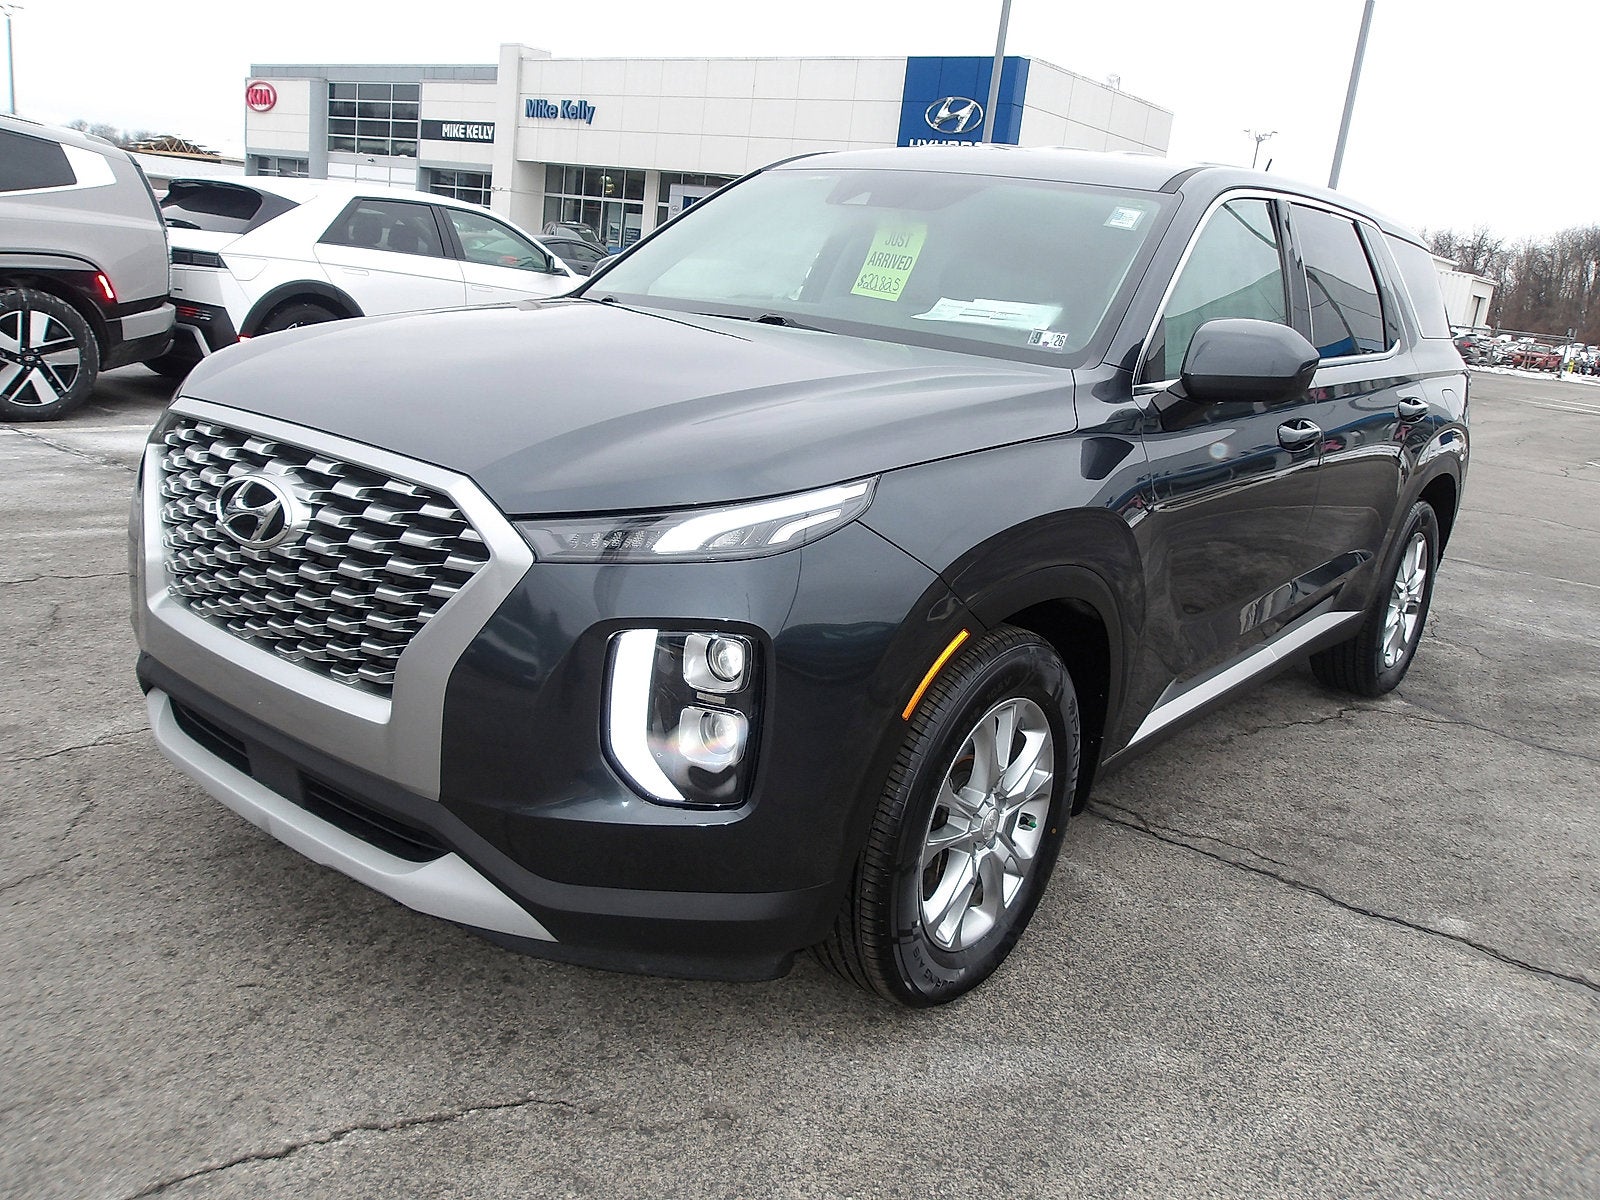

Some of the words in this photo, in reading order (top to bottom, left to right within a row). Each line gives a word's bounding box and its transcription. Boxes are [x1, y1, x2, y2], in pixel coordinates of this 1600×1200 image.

[250, 88, 272, 105] KIA
[525, 99, 559, 119] Mike
[560, 99, 596, 125] Kelly
[441, 123, 466, 138] MIKE
[466, 124, 494, 140] KELLY
[884, 231, 912, 248] JUST
[867, 251, 913, 271] ARRIVED
[1053, 334, 1066, 347] 26
